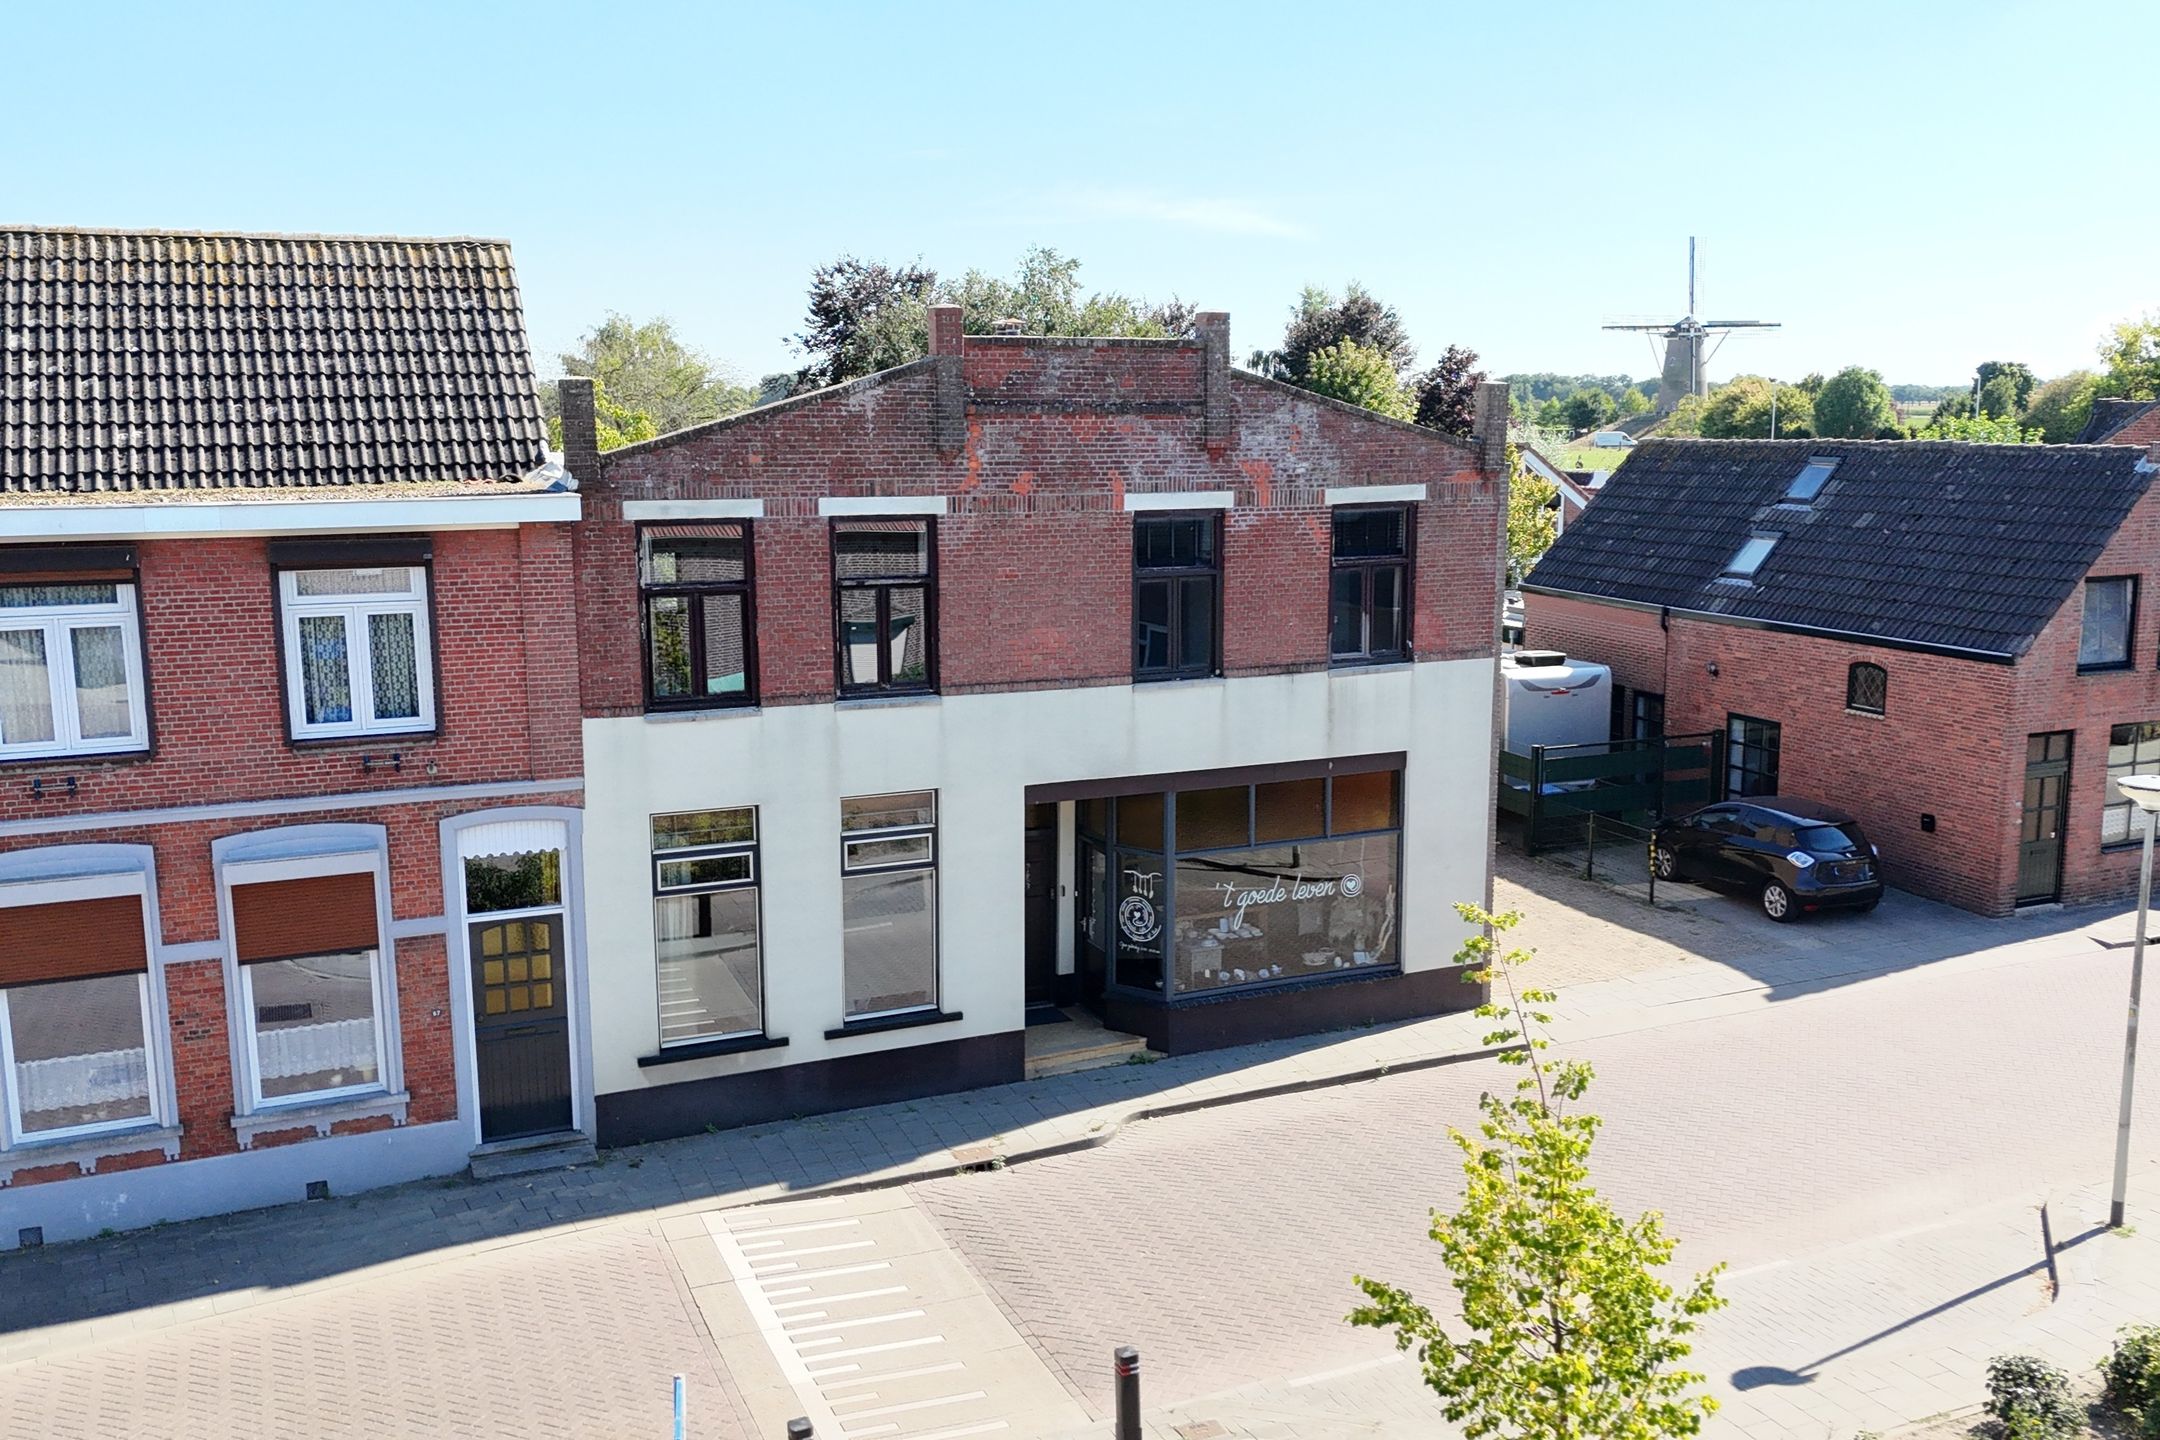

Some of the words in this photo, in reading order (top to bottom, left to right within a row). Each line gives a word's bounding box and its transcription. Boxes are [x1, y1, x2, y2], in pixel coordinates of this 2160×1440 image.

[1215, 881, 1236, 908] 't
[1233, 875, 1288, 930] goede
[1291, 873, 1336, 900] leven
